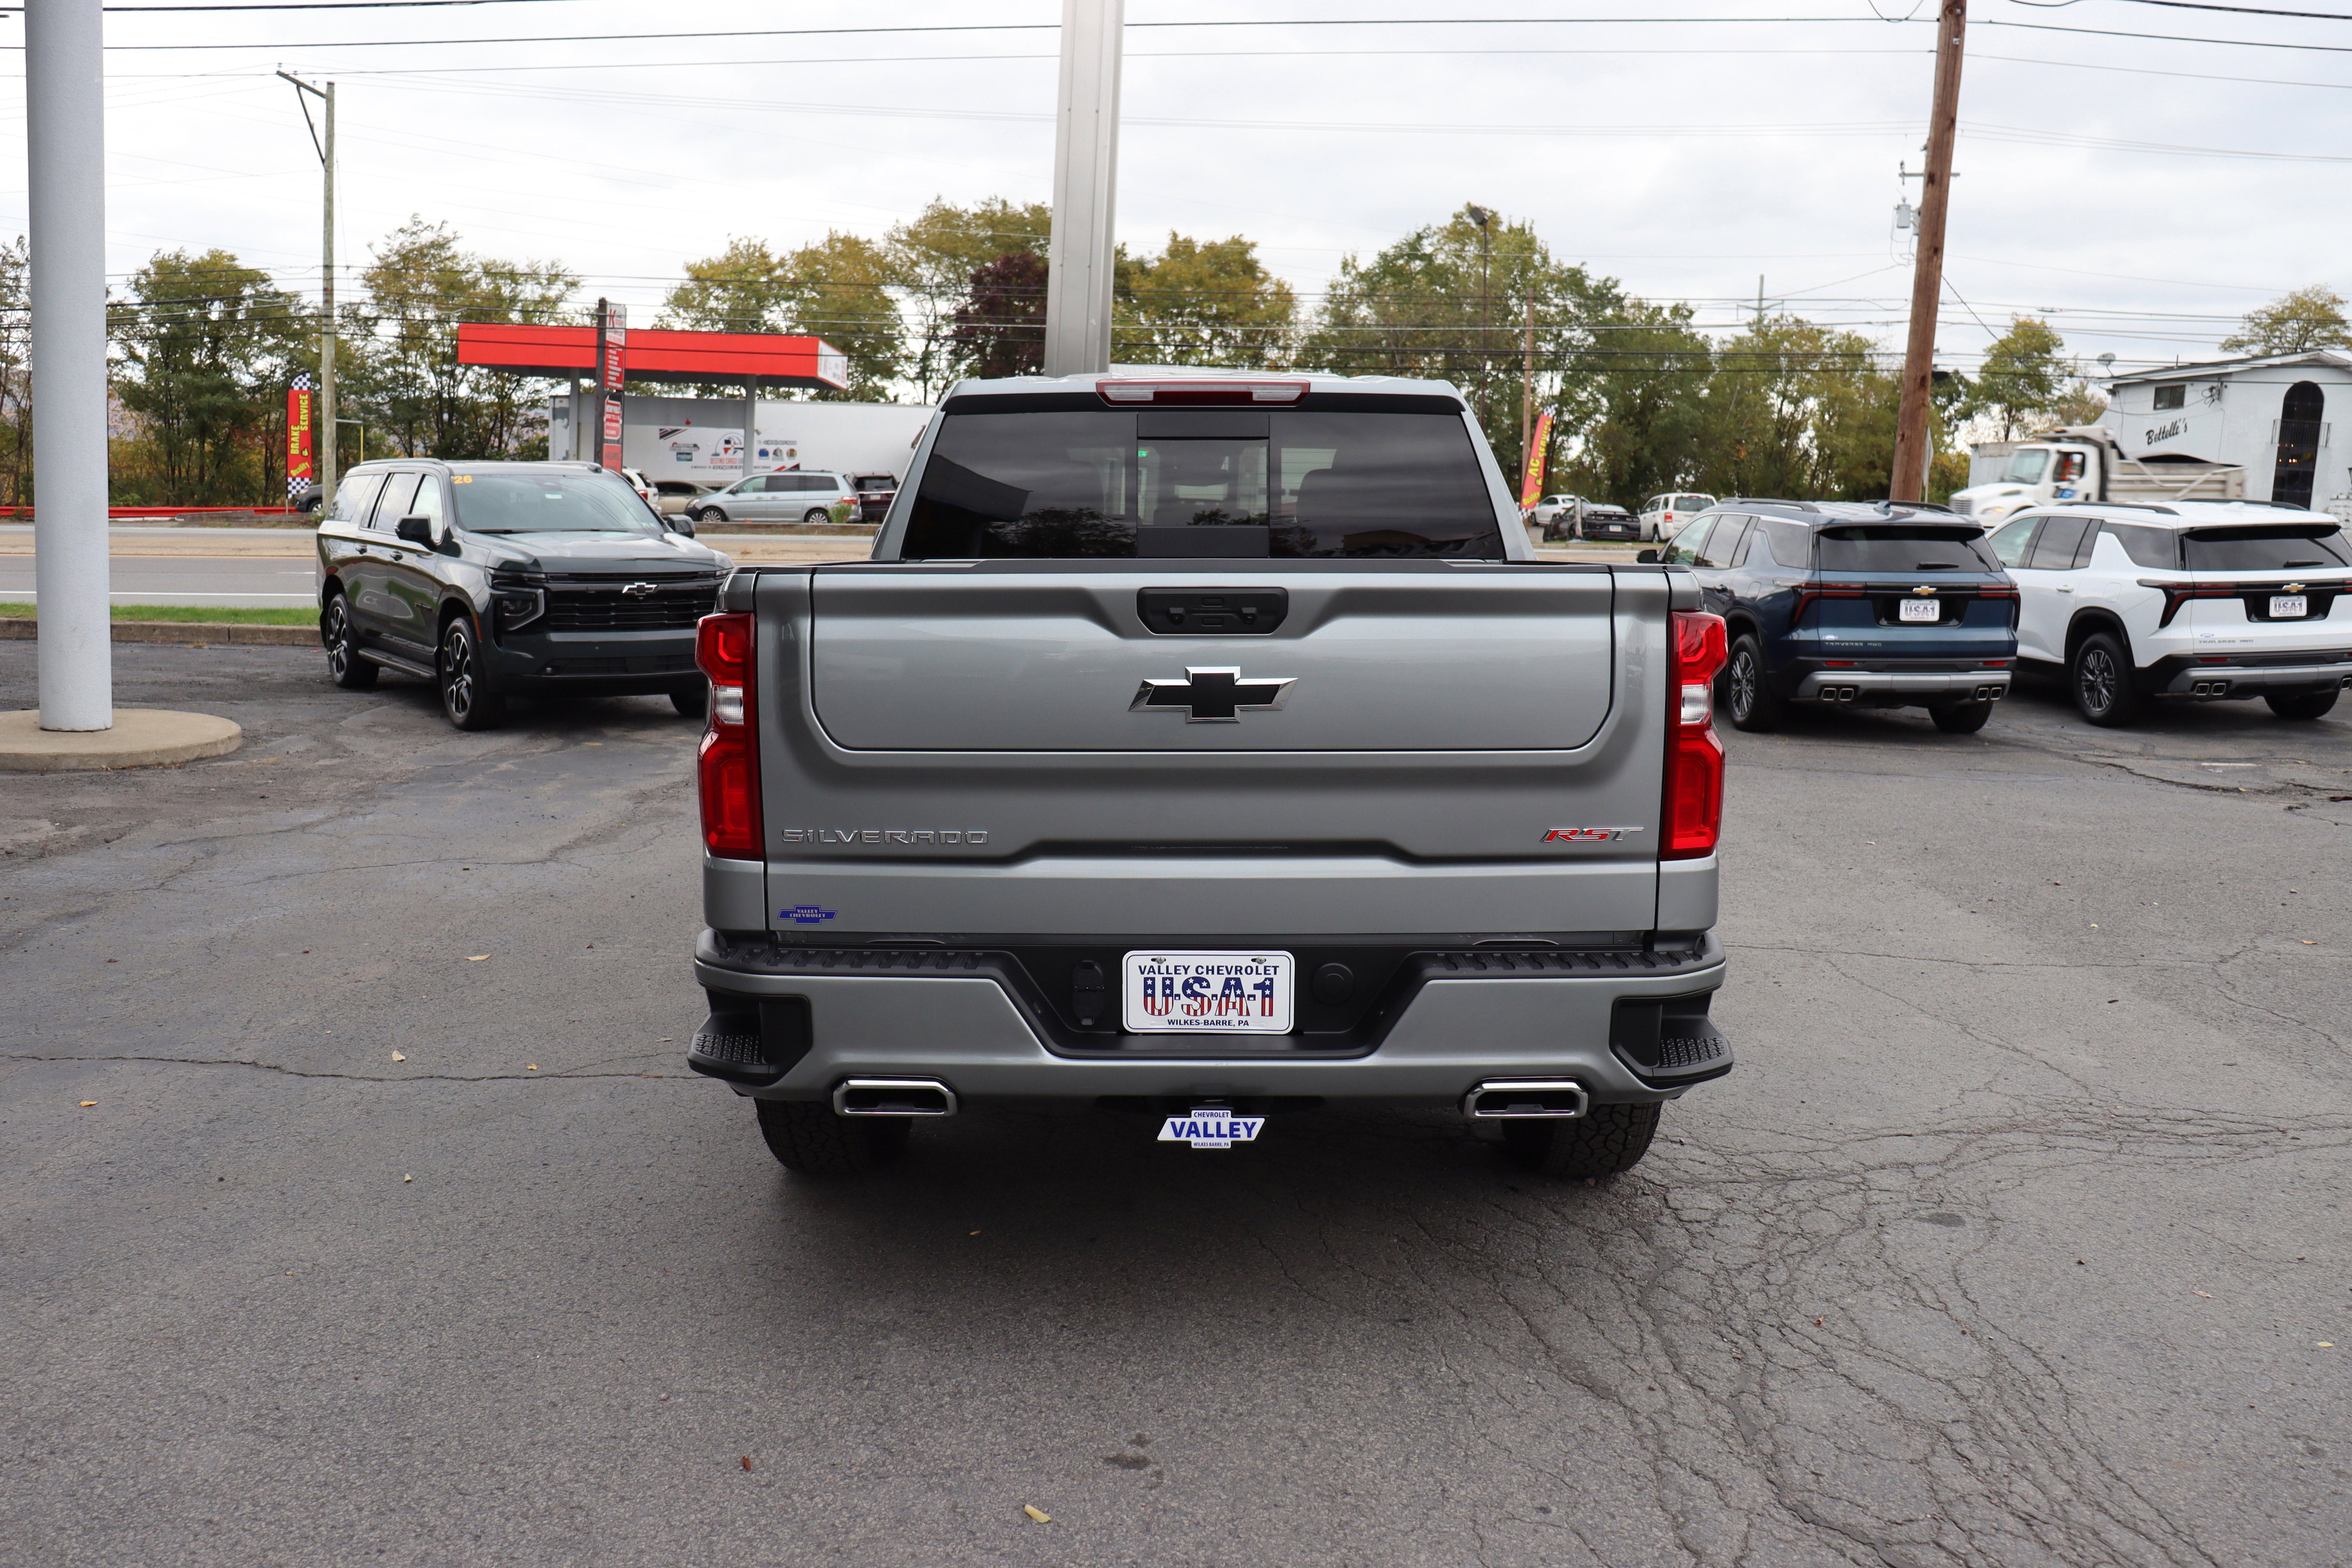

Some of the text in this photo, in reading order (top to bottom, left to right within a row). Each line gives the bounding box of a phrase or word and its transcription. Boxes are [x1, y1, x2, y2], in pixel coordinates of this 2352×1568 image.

[299, 393, 309, 431] SERVICE
[290, 425, 300, 454] BRAKE
[1528, 457, 1541, 477] AC
[782, 829, 989, 844] SILVERADO
[1539, 827, 1644, 842] RST
[1138, 965, 1279, 976] VALLEY CHEVROLET
[1167, 1019, 1235, 1027] WILKES-BARRE,
[1170, 1121, 1257, 1138] VALLEY
